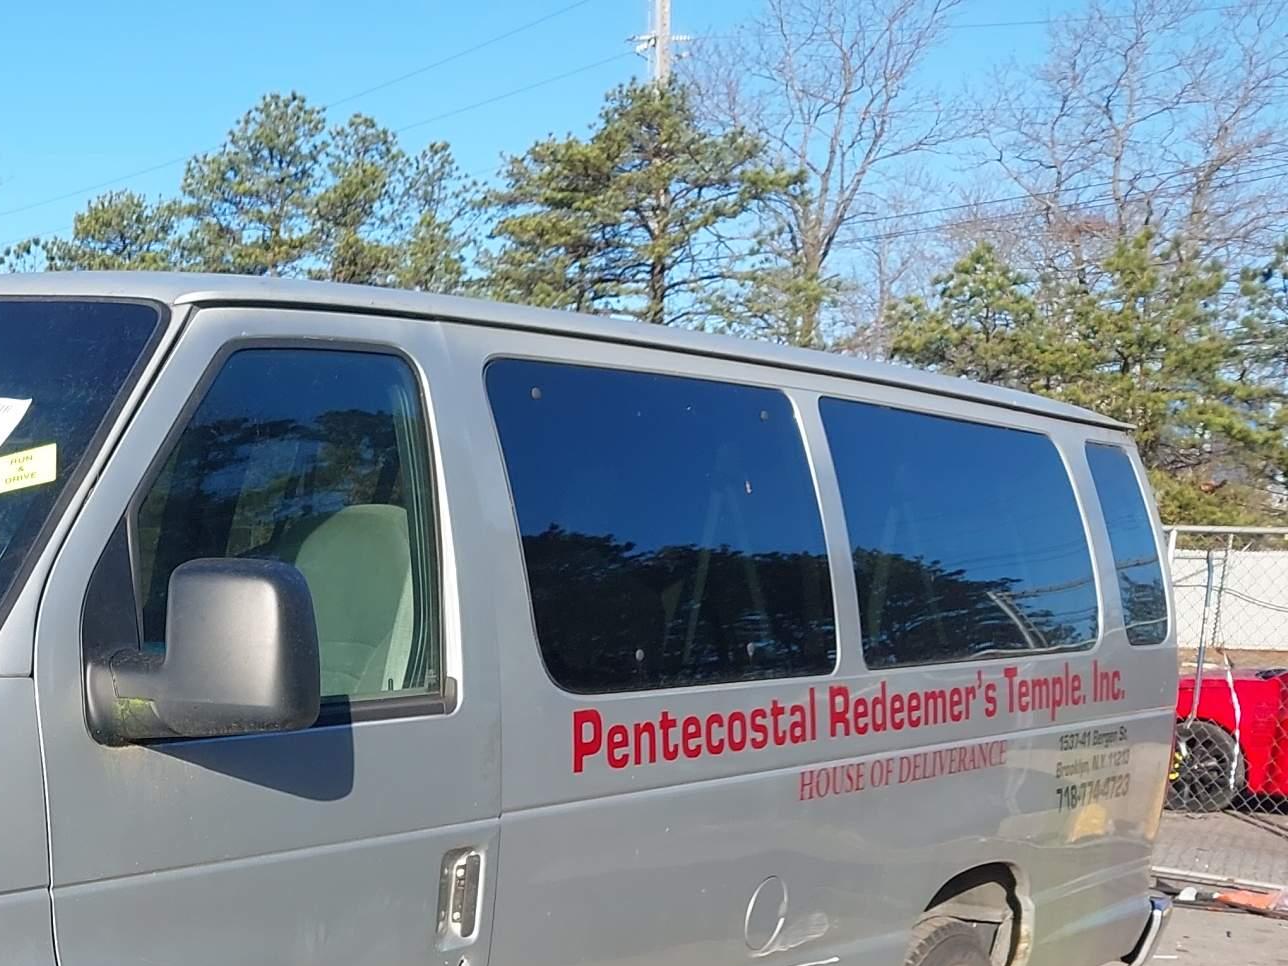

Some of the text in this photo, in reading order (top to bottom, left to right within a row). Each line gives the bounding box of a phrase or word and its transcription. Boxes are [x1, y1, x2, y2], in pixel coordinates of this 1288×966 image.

[4, 471, 38, 485] DRIVE
[572, 687, 817, 773] Pentecostal
[829, 669, 998, 738] Redeemer's
[1092, 659, 1126, 703] Inc.
[799, 739, 1008, 802] HOUSE OF DELIVERANCE
